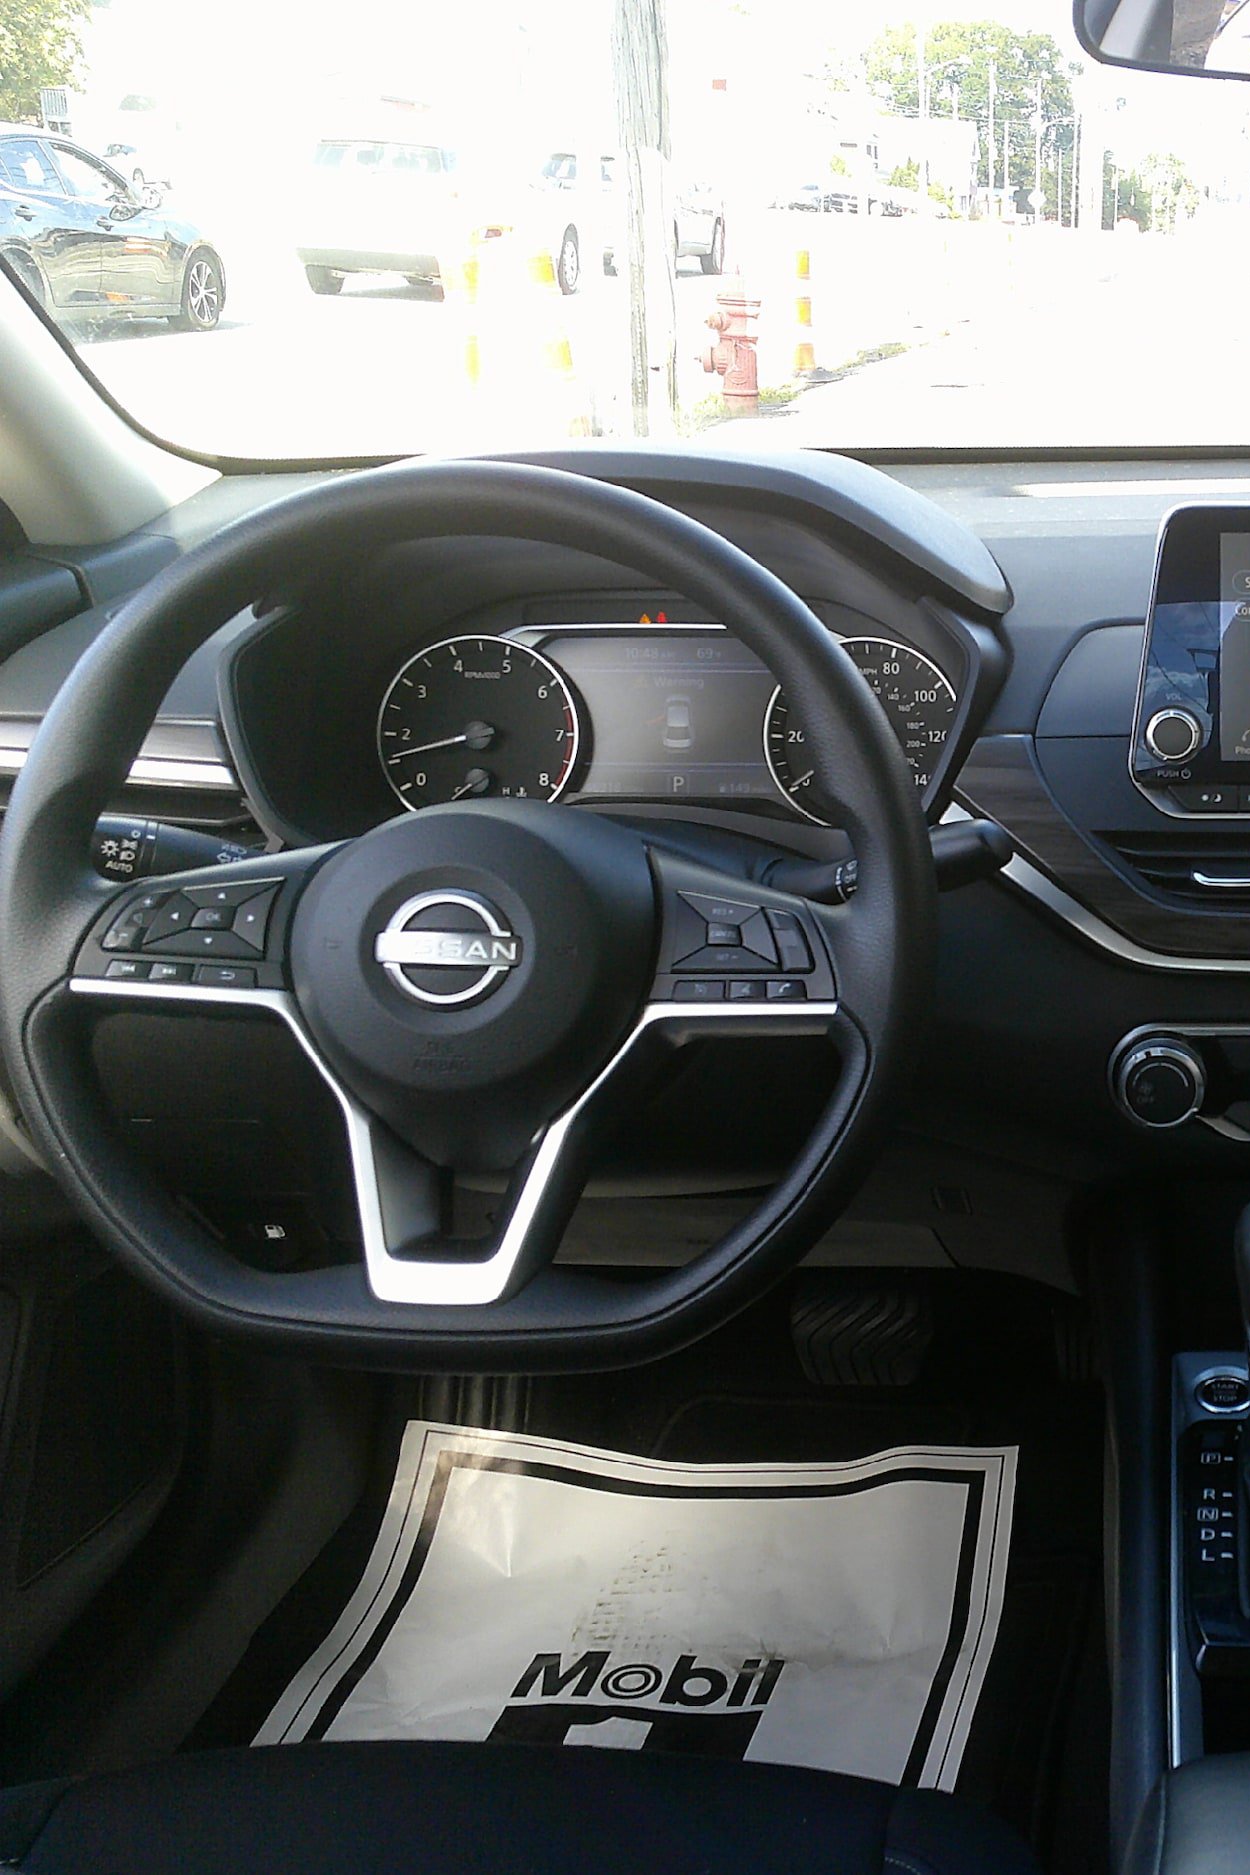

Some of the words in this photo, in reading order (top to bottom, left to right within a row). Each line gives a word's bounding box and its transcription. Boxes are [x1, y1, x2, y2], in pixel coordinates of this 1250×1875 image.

[453, 660, 463, 672] 4
[502, 660, 512, 673] 5
[883, 662, 900, 675] 80
[654, 676, 704, 690] Warning
[418, 685, 427, 699] 3
[538, 685, 548, 699] 6
[914, 690, 937, 702] 100
[402, 729, 411, 741] 2
[555, 730, 564, 742] 7
[416, 773, 426, 786] 0
[538, 773, 549, 786] 8
[914, 774, 931, 785] 14
[1157, 770, 1180, 778] PUSH
[673, 776, 684, 792] P
[502, 787, 510, 795] H
[105, 860, 133, 873] AUTO
[1203, 1488, 1215, 1500] R
[1200, 1528, 1215, 1541] D
[1202, 1549, 1215, 1561] L
[511, 1652, 786, 1708] Mobil
